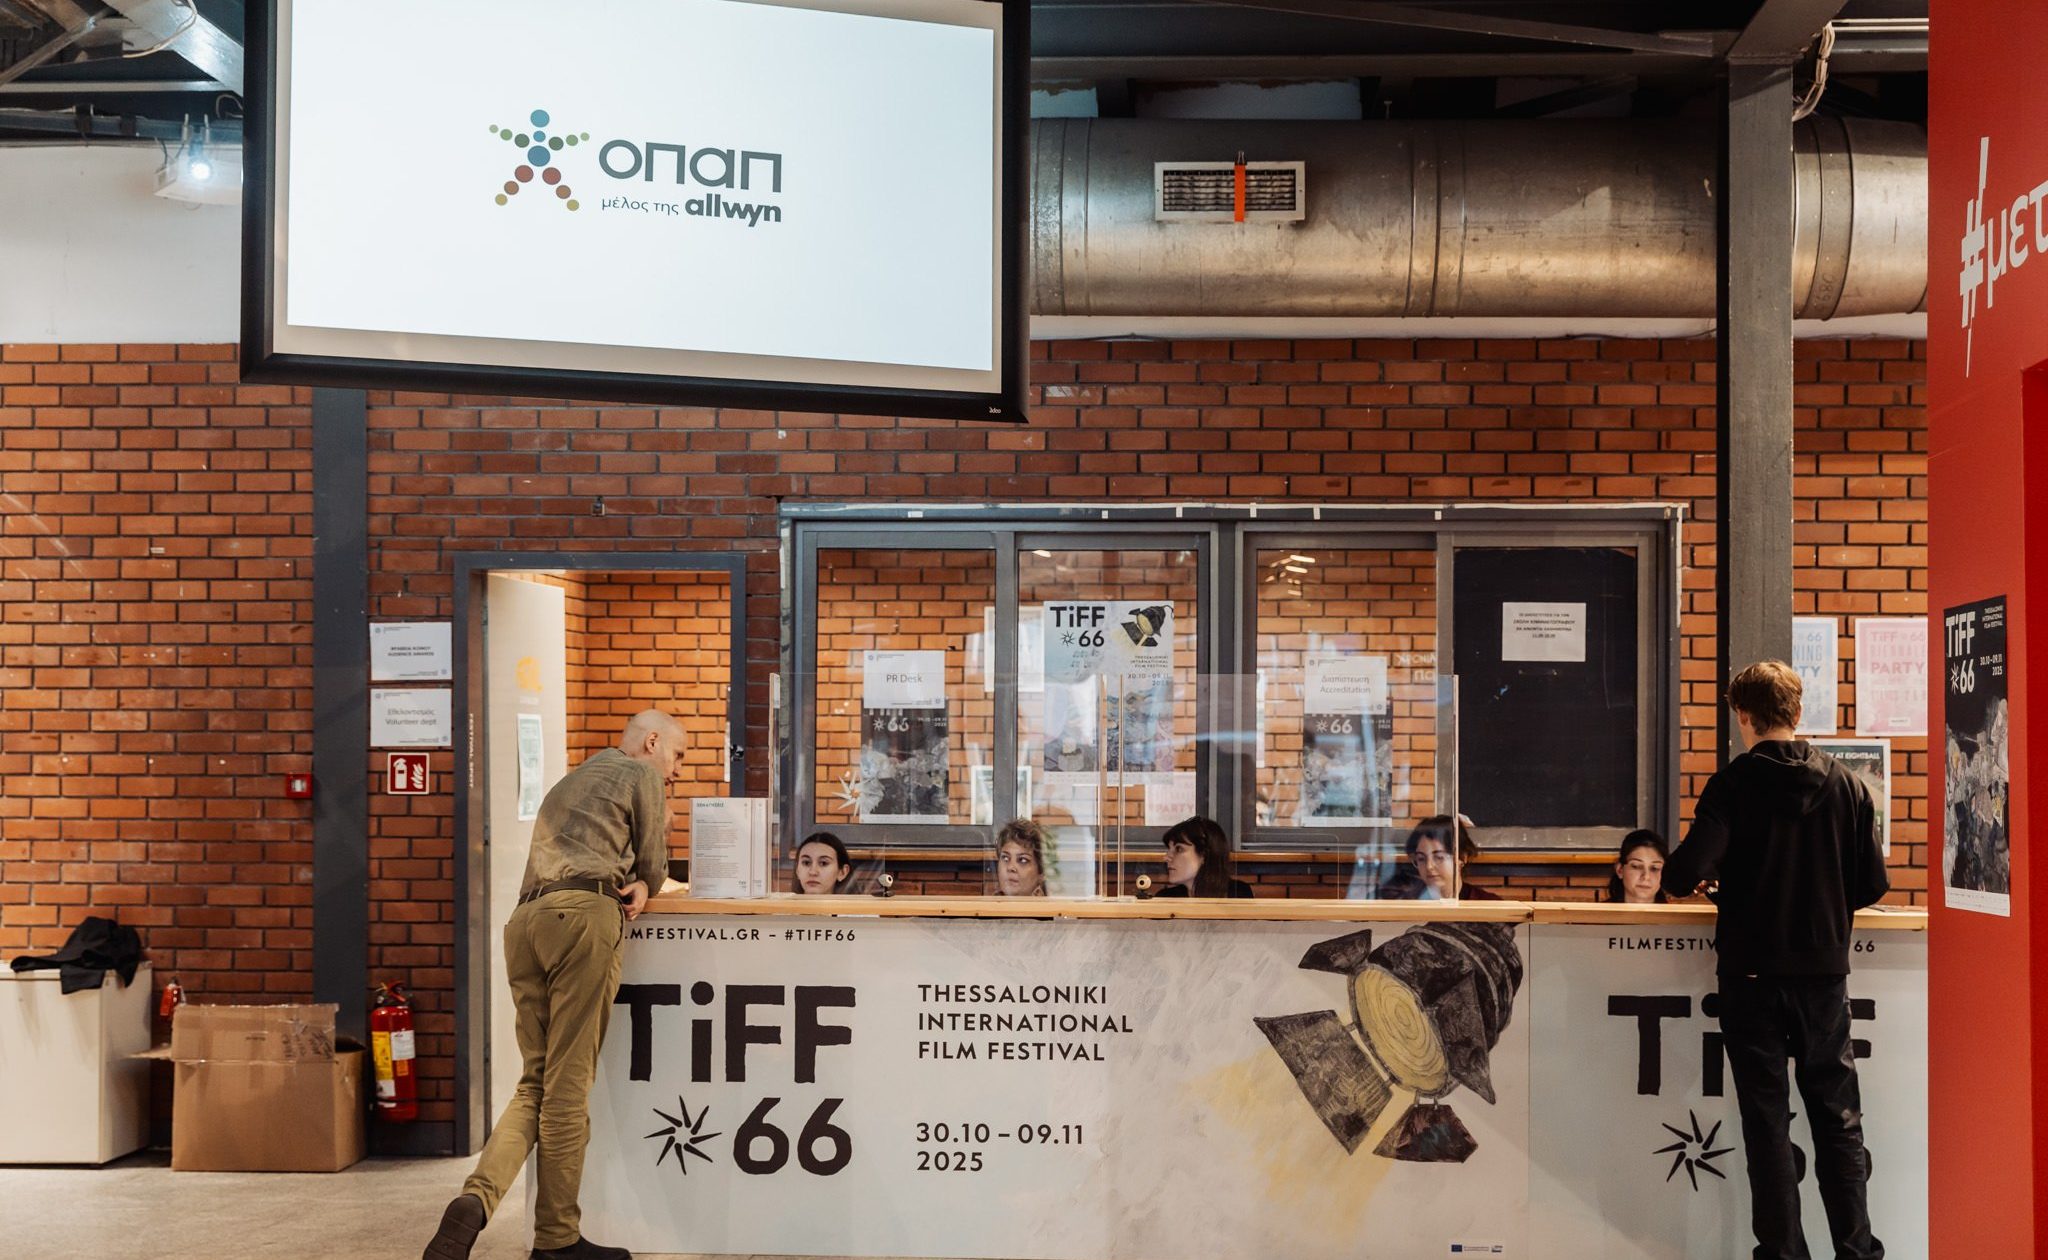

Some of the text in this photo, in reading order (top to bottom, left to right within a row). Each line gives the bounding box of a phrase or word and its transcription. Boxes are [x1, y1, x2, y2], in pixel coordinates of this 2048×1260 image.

[602, 193, 782, 227] μέλος της allwyn
[1078, 630, 1105, 647] 66
[1808, 633, 1822, 641] 66
[1793, 645, 1823, 662] NING
[1795, 666, 1821, 677] TY
[1871, 662, 1925, 674] PARTY
[1992, 666, 2003, 676] 2025
[886, 674, 922, 683] PR Desk
[1960, 658, 1975, 694] 66
[1320, 686, 1371, 694] Accreditation
[385, 718, 418, 726] Volunteer
[887, 717, 909, 732] 66
[1330, 719, 1353, 734] 66
[625, 928, 760, 941] MFESTIVAL.GR
[785, 929, 856, 941] #TIFF66
[918, 984, 1108, 1005] THESSALONIKI
[918, 1013, 1134, 1033] INTERNATIONAL
[918, 1041, 1105, 1062] FILM FESTIVAL
[733, 1097, 853, 1176] 66
[916, 1151, 984, 1173] 2025
